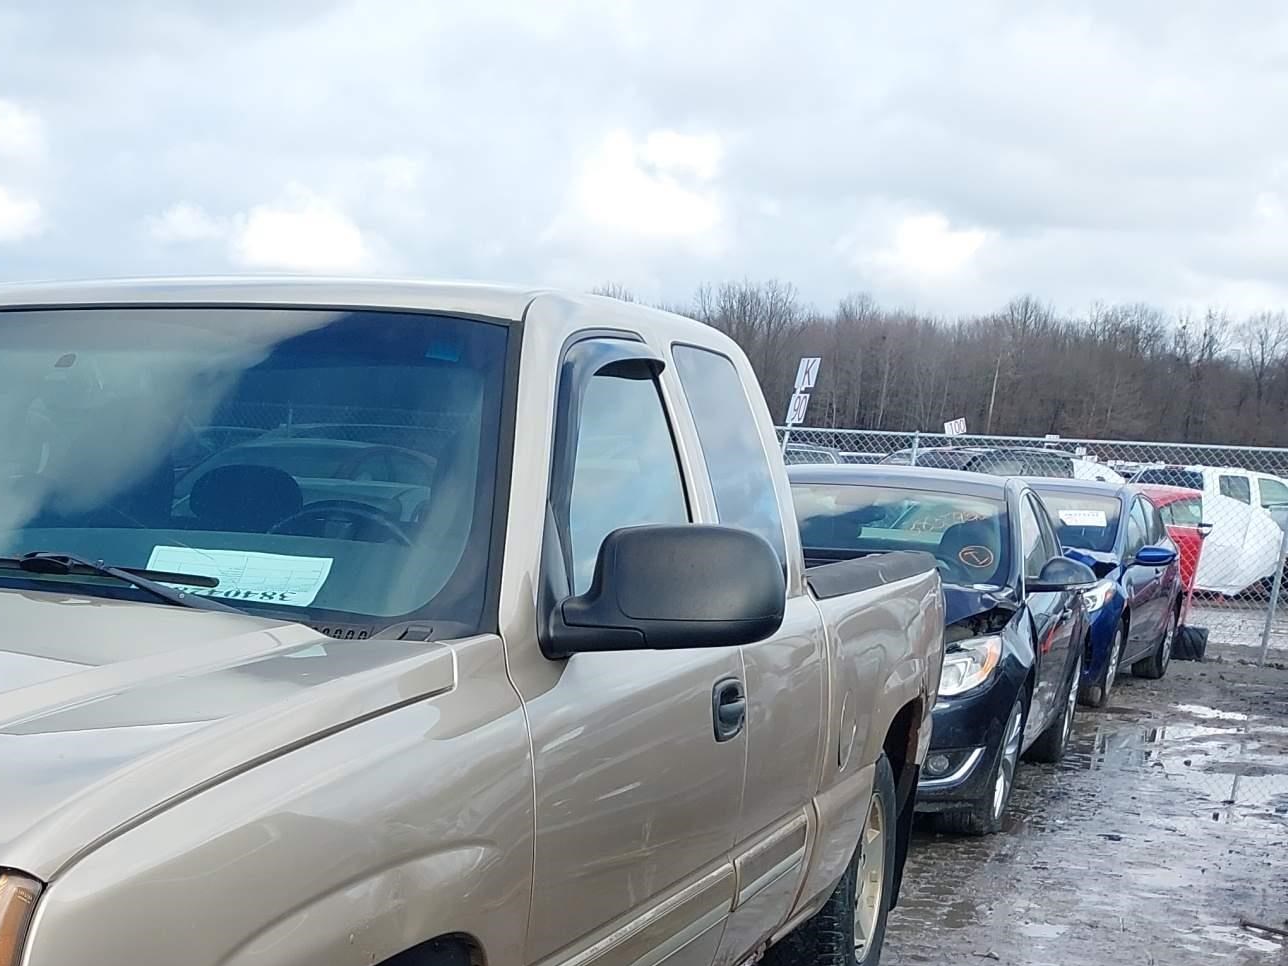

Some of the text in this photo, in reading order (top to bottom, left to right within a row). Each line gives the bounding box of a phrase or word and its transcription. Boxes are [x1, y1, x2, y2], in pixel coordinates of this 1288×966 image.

[802, 359, 817, 387] K
[790, 395, 808, 422] 90
[949, 419, 967, 434] 100
